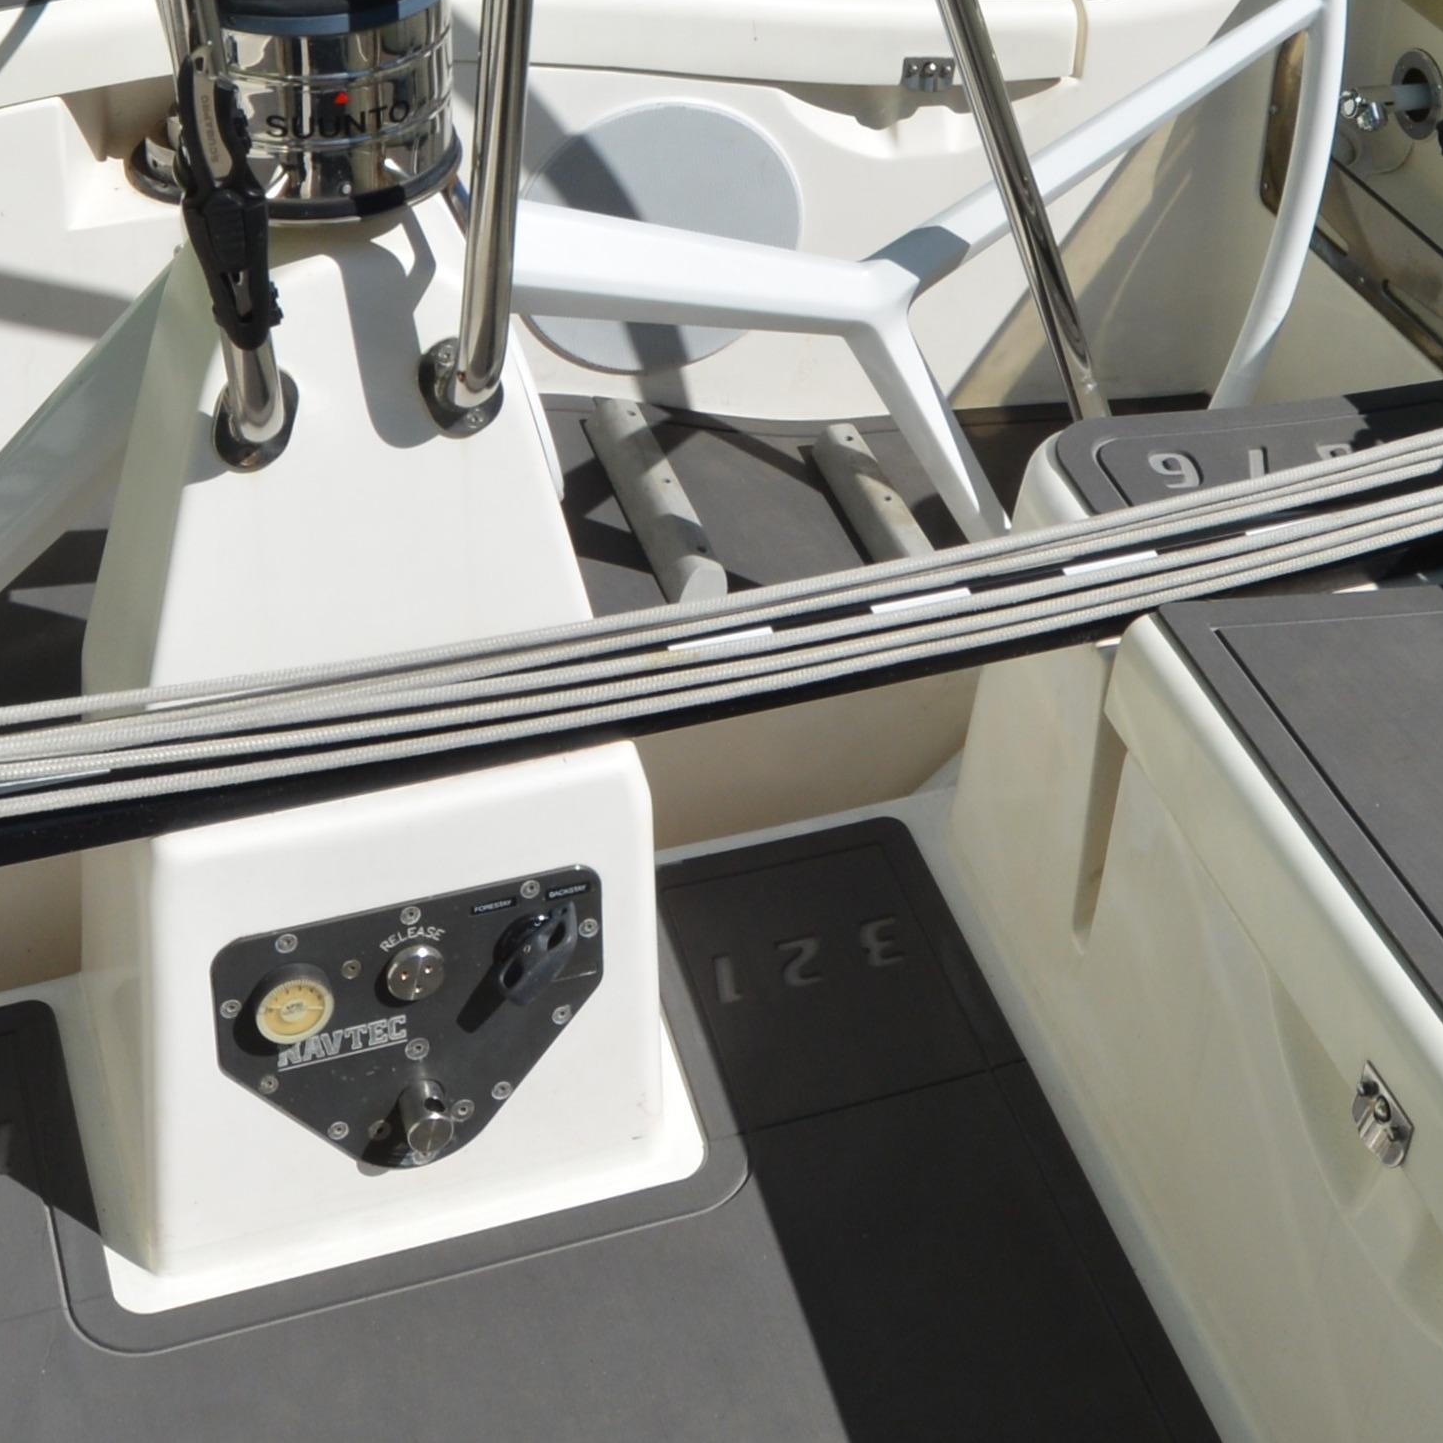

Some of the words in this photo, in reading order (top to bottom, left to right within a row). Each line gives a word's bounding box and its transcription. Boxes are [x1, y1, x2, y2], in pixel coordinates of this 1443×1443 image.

[266, 100, 411, 139] SUUNTO
[379, 925, 446, 953] RELEASE
[277, 1014, 407, 1069] NAVTEC
